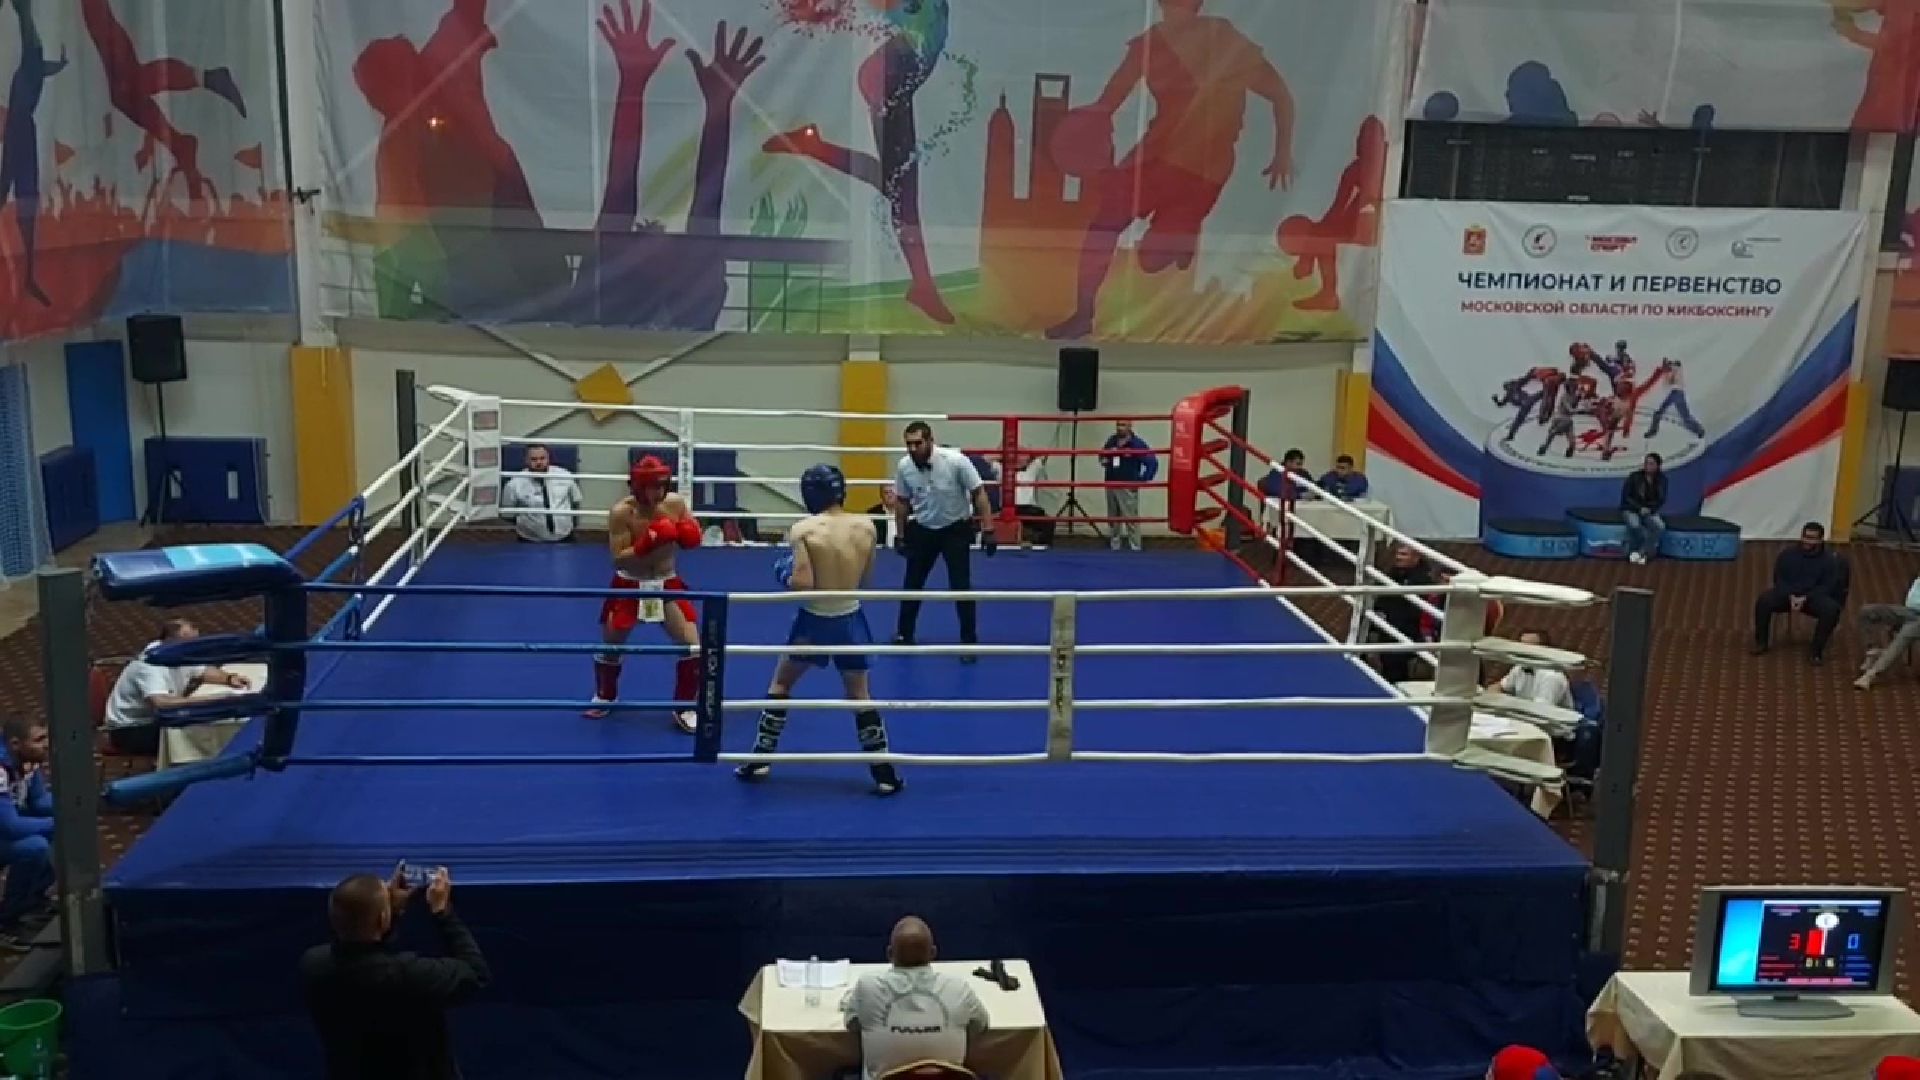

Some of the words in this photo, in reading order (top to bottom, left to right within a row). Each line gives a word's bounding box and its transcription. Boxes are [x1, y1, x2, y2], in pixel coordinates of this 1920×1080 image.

[1458, 271, 1604, 292] ЧЕМПИОНАТ
[1610, 275, 1626, 292] И
[1632, 275, 1782, 295] ПЕРВЕНСТВО
[1461, 299, 1565, 314] МОСКОВСКОЙ
[1569, 302, 1639, 315] ОБЛАСТИ
[1642, 304, 1664, 316] ПО
[1666, 304, 1774, 319] КИКБОКСИНГУ
[1788, 933, 1801, 949] 3
[1847, 933, 1859, 949] 0
